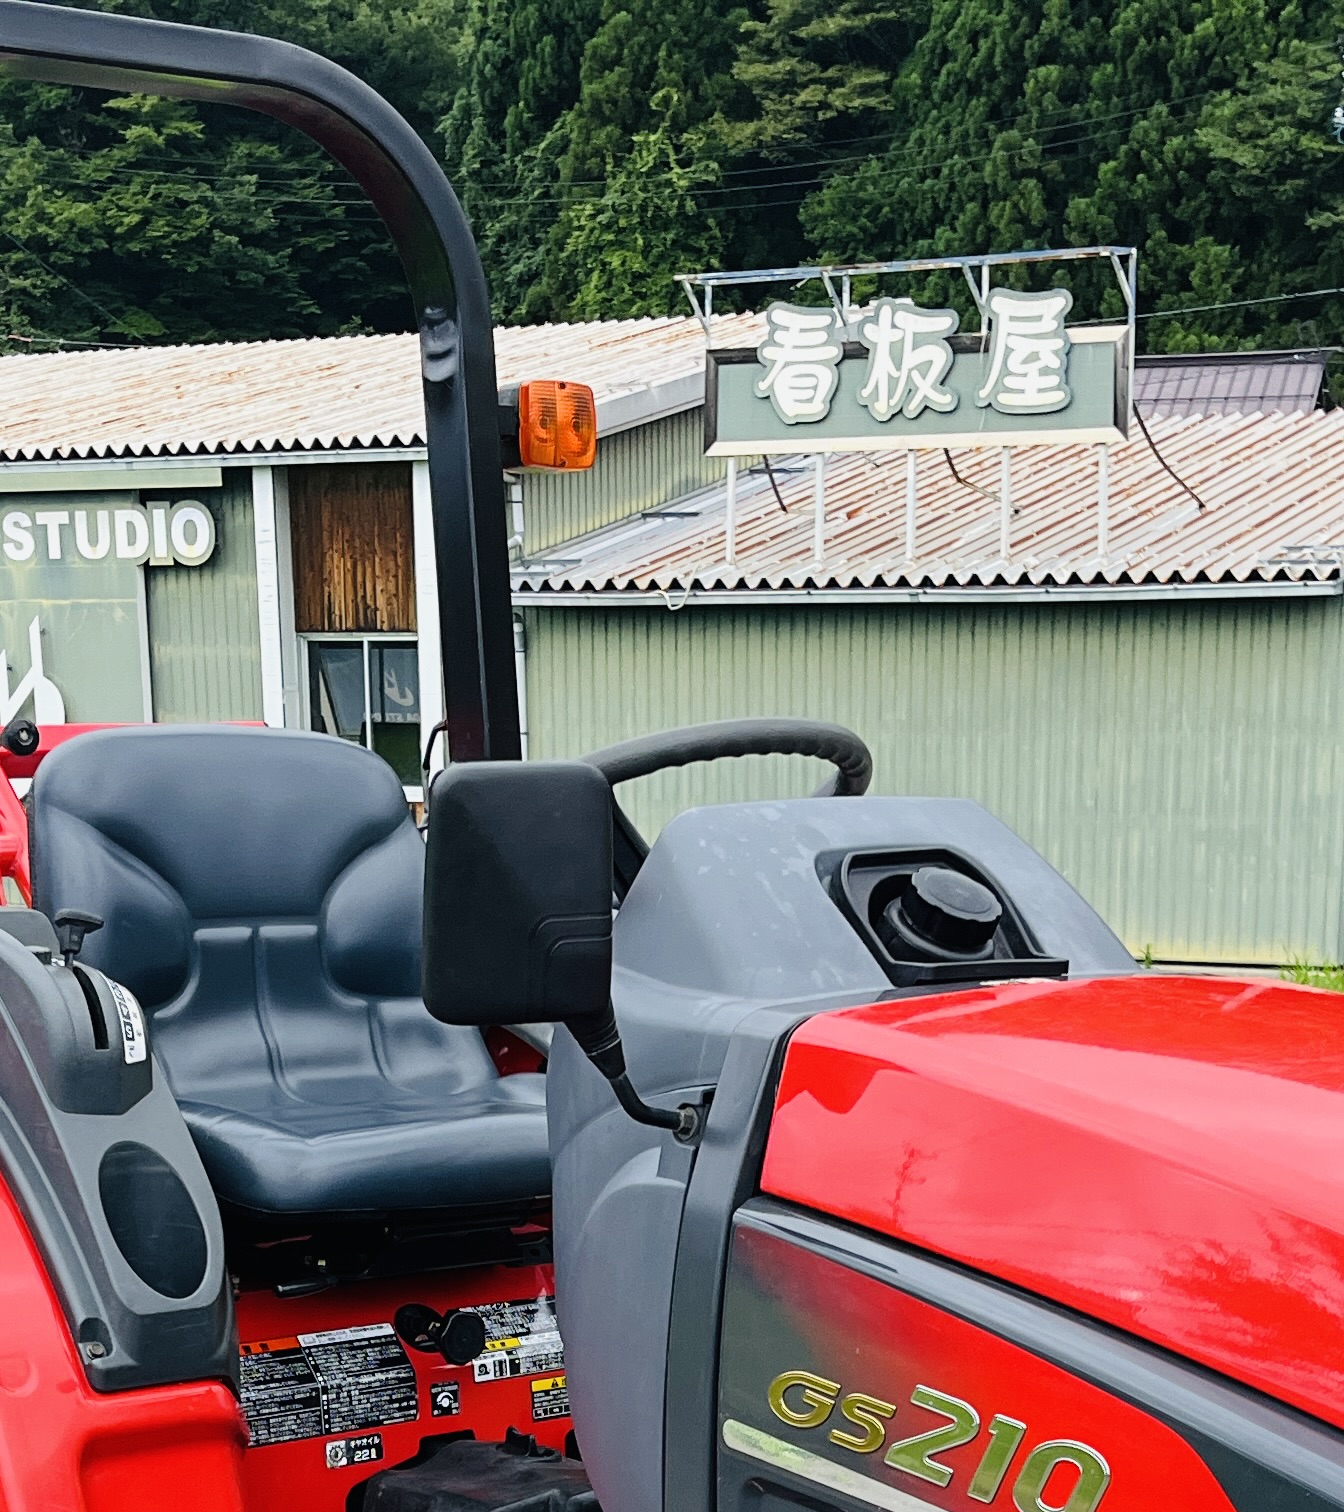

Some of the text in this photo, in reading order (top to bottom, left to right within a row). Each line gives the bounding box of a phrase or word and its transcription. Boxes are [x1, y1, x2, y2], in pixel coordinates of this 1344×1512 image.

[758, 292, 1070, 421] 看板屋
[2, 506, 211, 561] STUDIO
